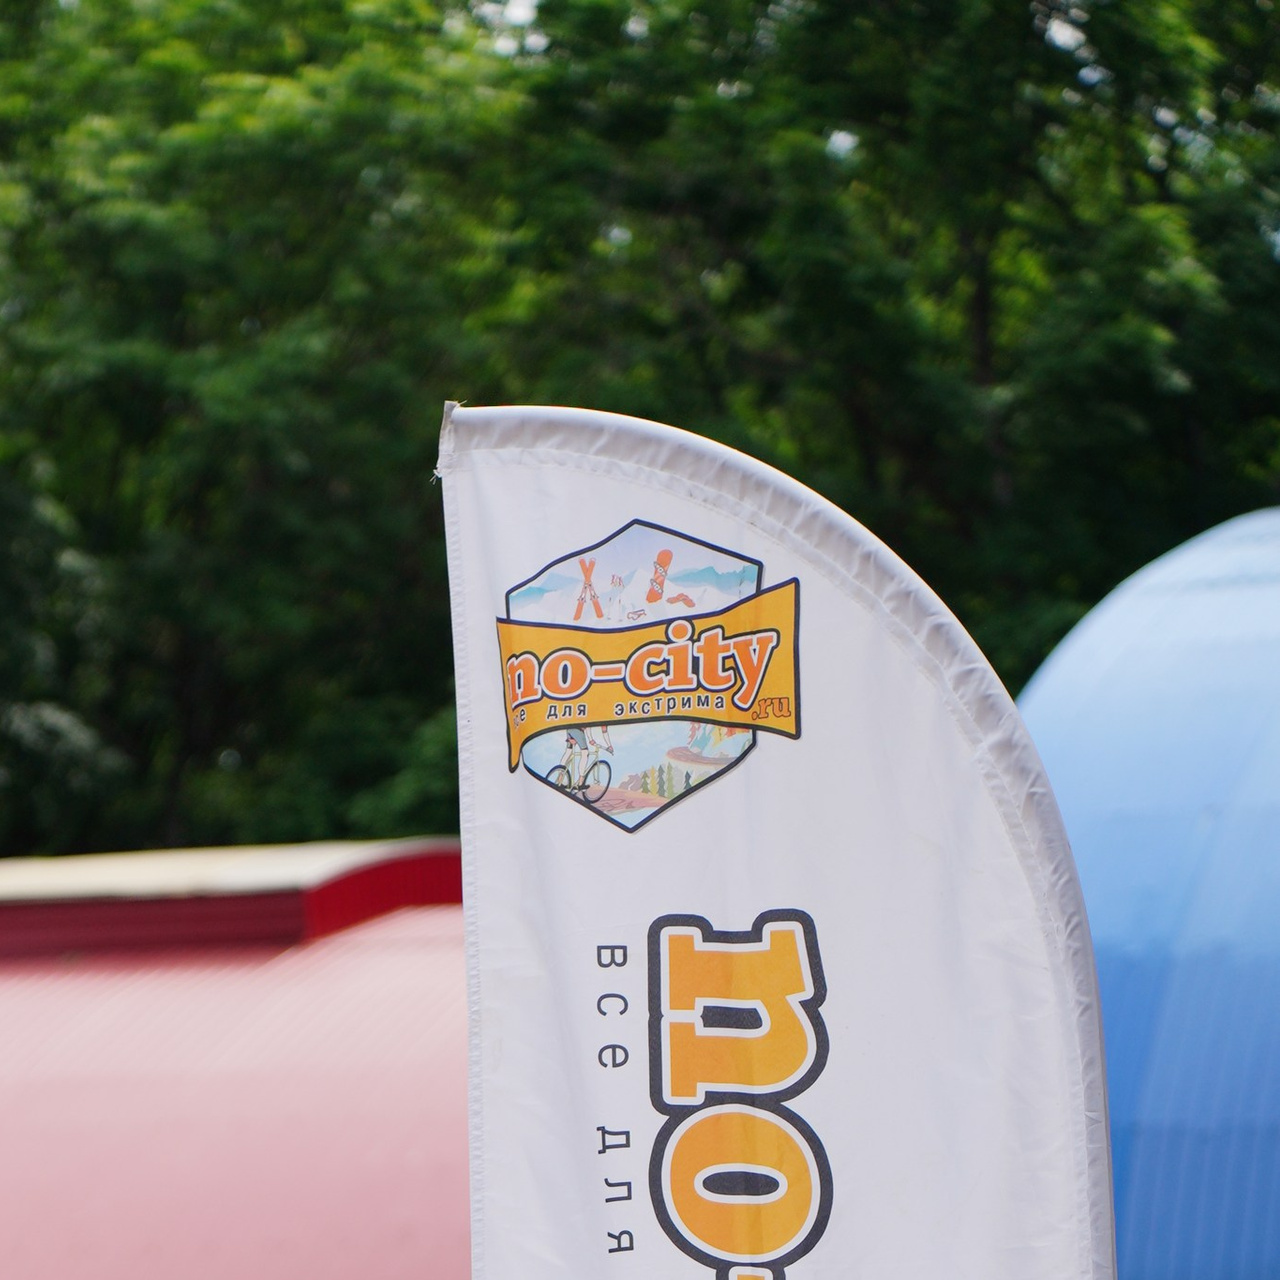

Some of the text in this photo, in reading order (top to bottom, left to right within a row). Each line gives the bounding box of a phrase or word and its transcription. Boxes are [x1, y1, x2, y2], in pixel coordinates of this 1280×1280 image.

[506, 619, 780, 712] no-city
[547, 704, 587, 719] для
[614, 694, 726, 717] экстрима
[751, 697, 792, 721] .ru
[596, 944, 628, 1069] все
[597, 1126, 635, 1254] для
